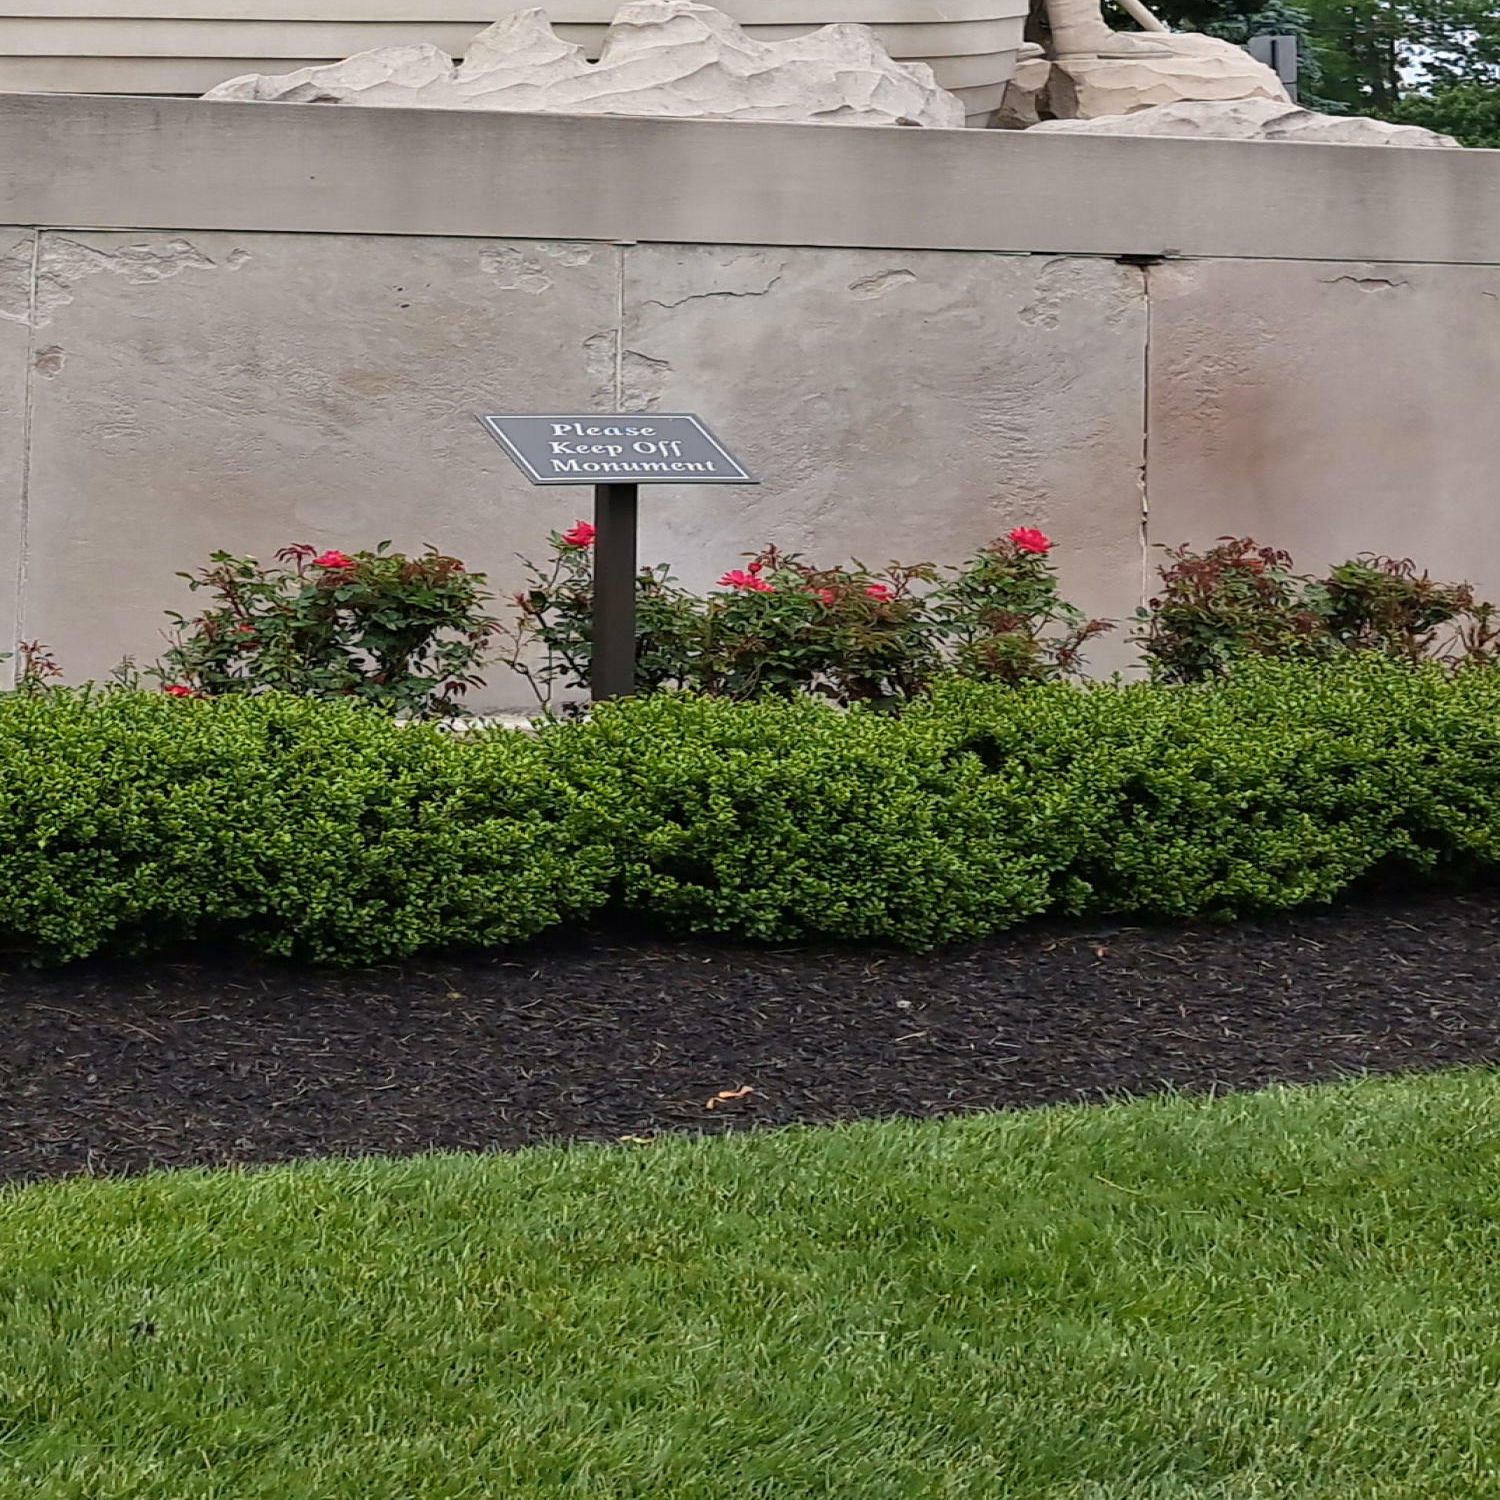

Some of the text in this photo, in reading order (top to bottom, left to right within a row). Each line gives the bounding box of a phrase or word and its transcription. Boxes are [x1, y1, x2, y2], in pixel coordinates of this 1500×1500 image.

[551, 423, 656, 436] Please
[549, 441, 682, 458] Keep Off
[552, 458, 717, 472] Monument
